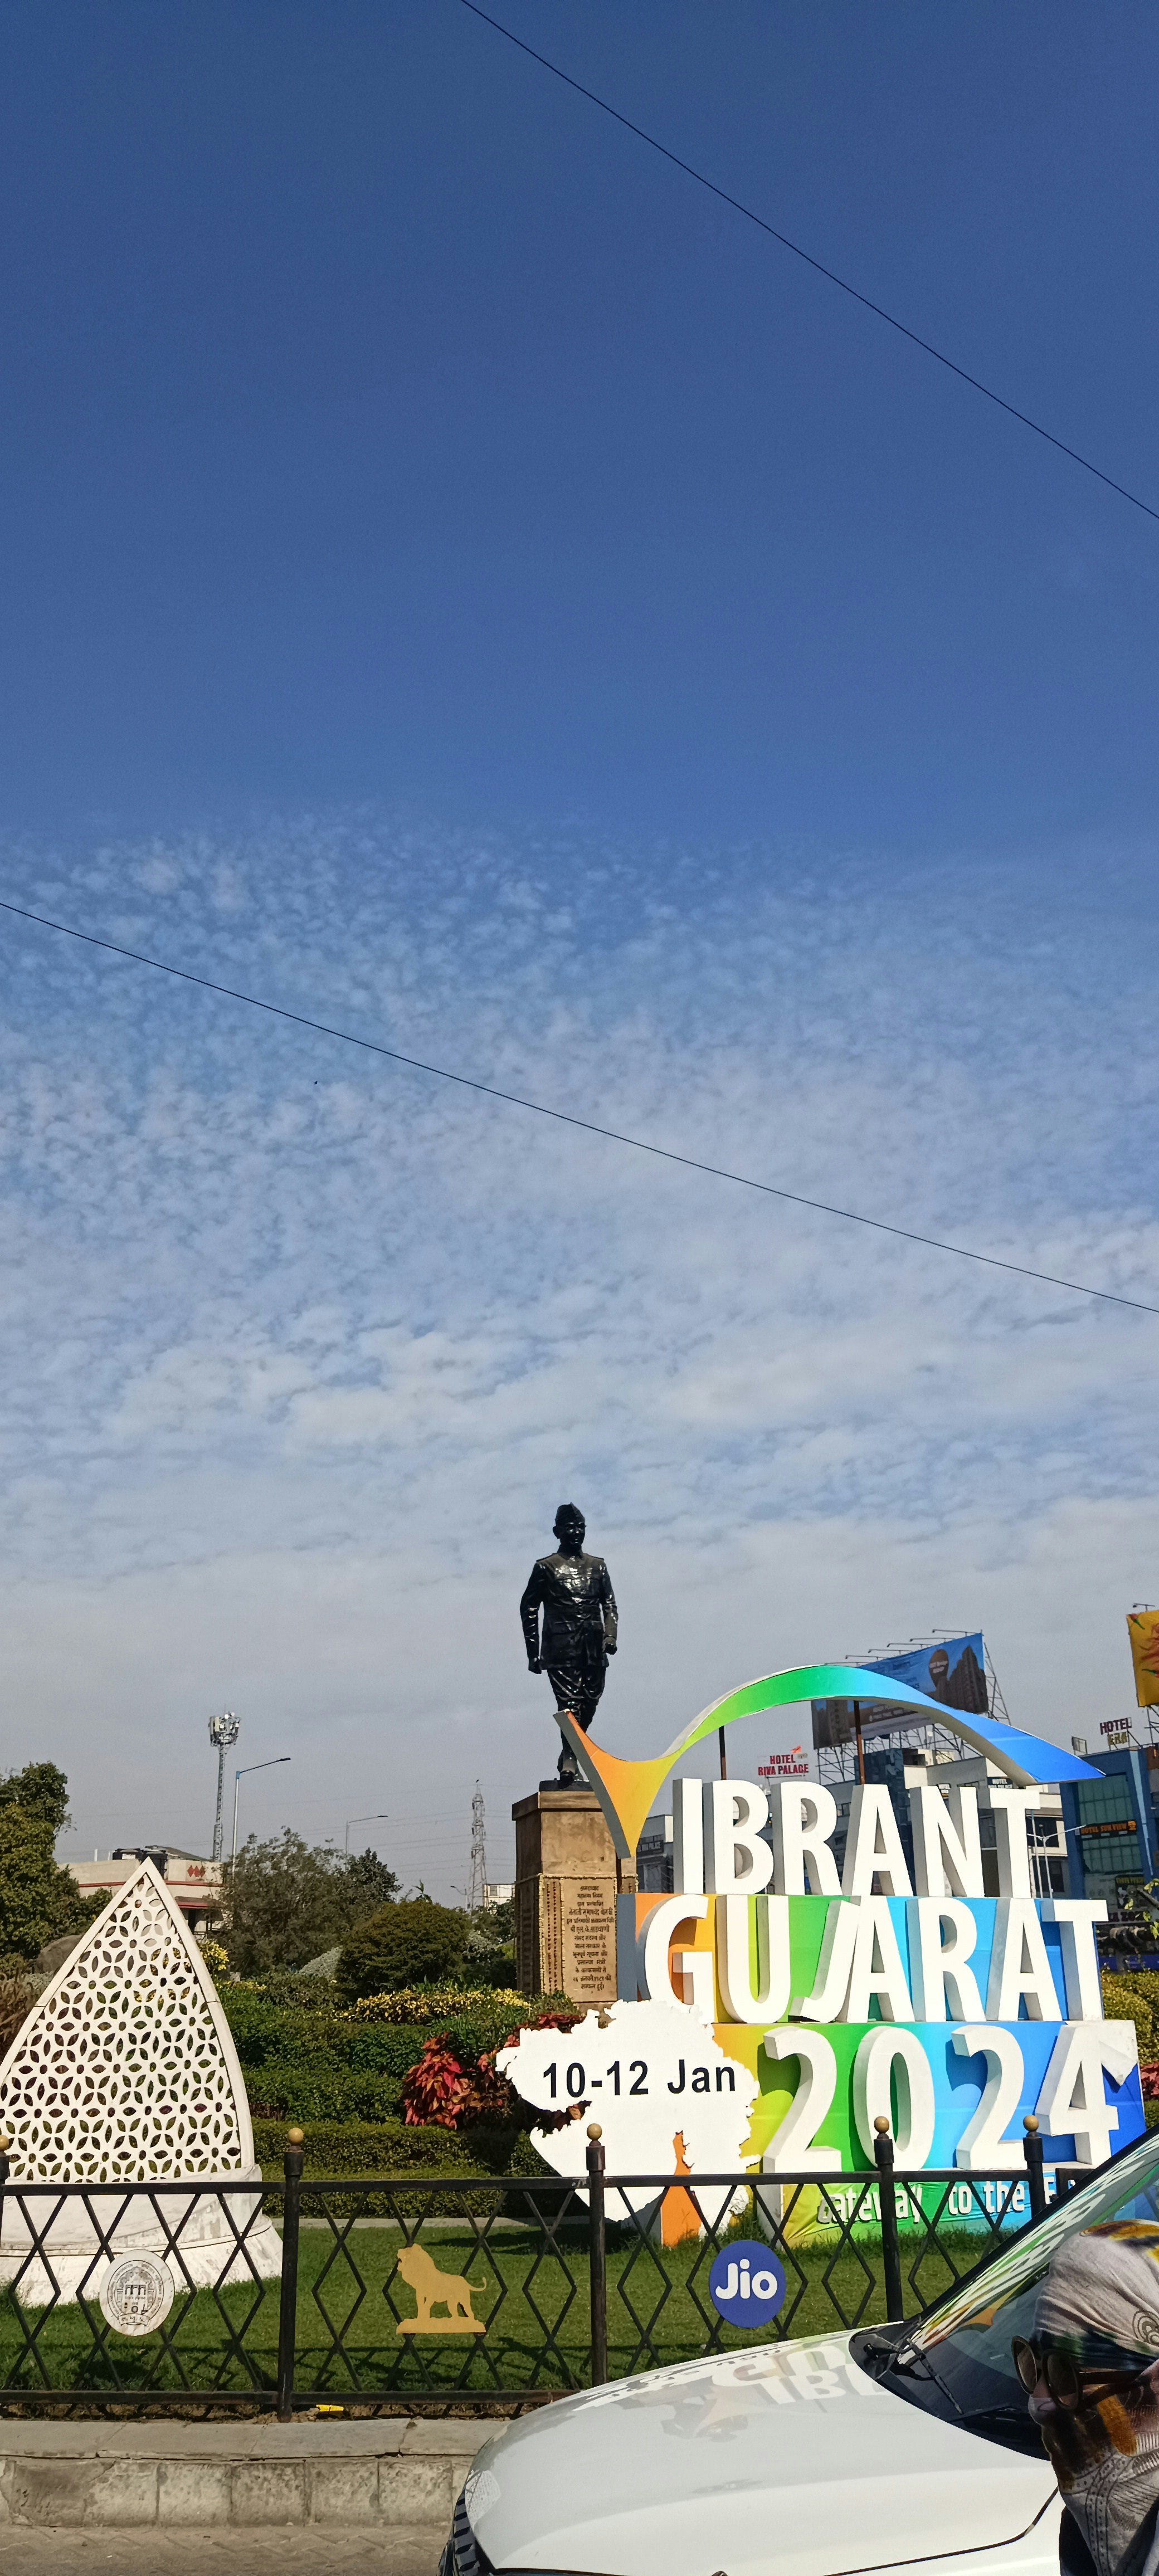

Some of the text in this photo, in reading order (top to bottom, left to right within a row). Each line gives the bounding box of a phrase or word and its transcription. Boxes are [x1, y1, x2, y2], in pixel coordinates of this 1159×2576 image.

[1099, 1717, 1132, 1735] HOTEL
[758, 1764, 809, 1775] RIVA PALACE
[770, 1754, 796, 1764] HOTEL
[636, 1893, 1109, 2024] GUJARAT
[543, 2058, 736, 2098] 10-12 Jan
[763, 2025, 1138, 2171] 2024
[983, 2179, 1025, 2212] the
[715, 2258, 778, 2300] Jio
